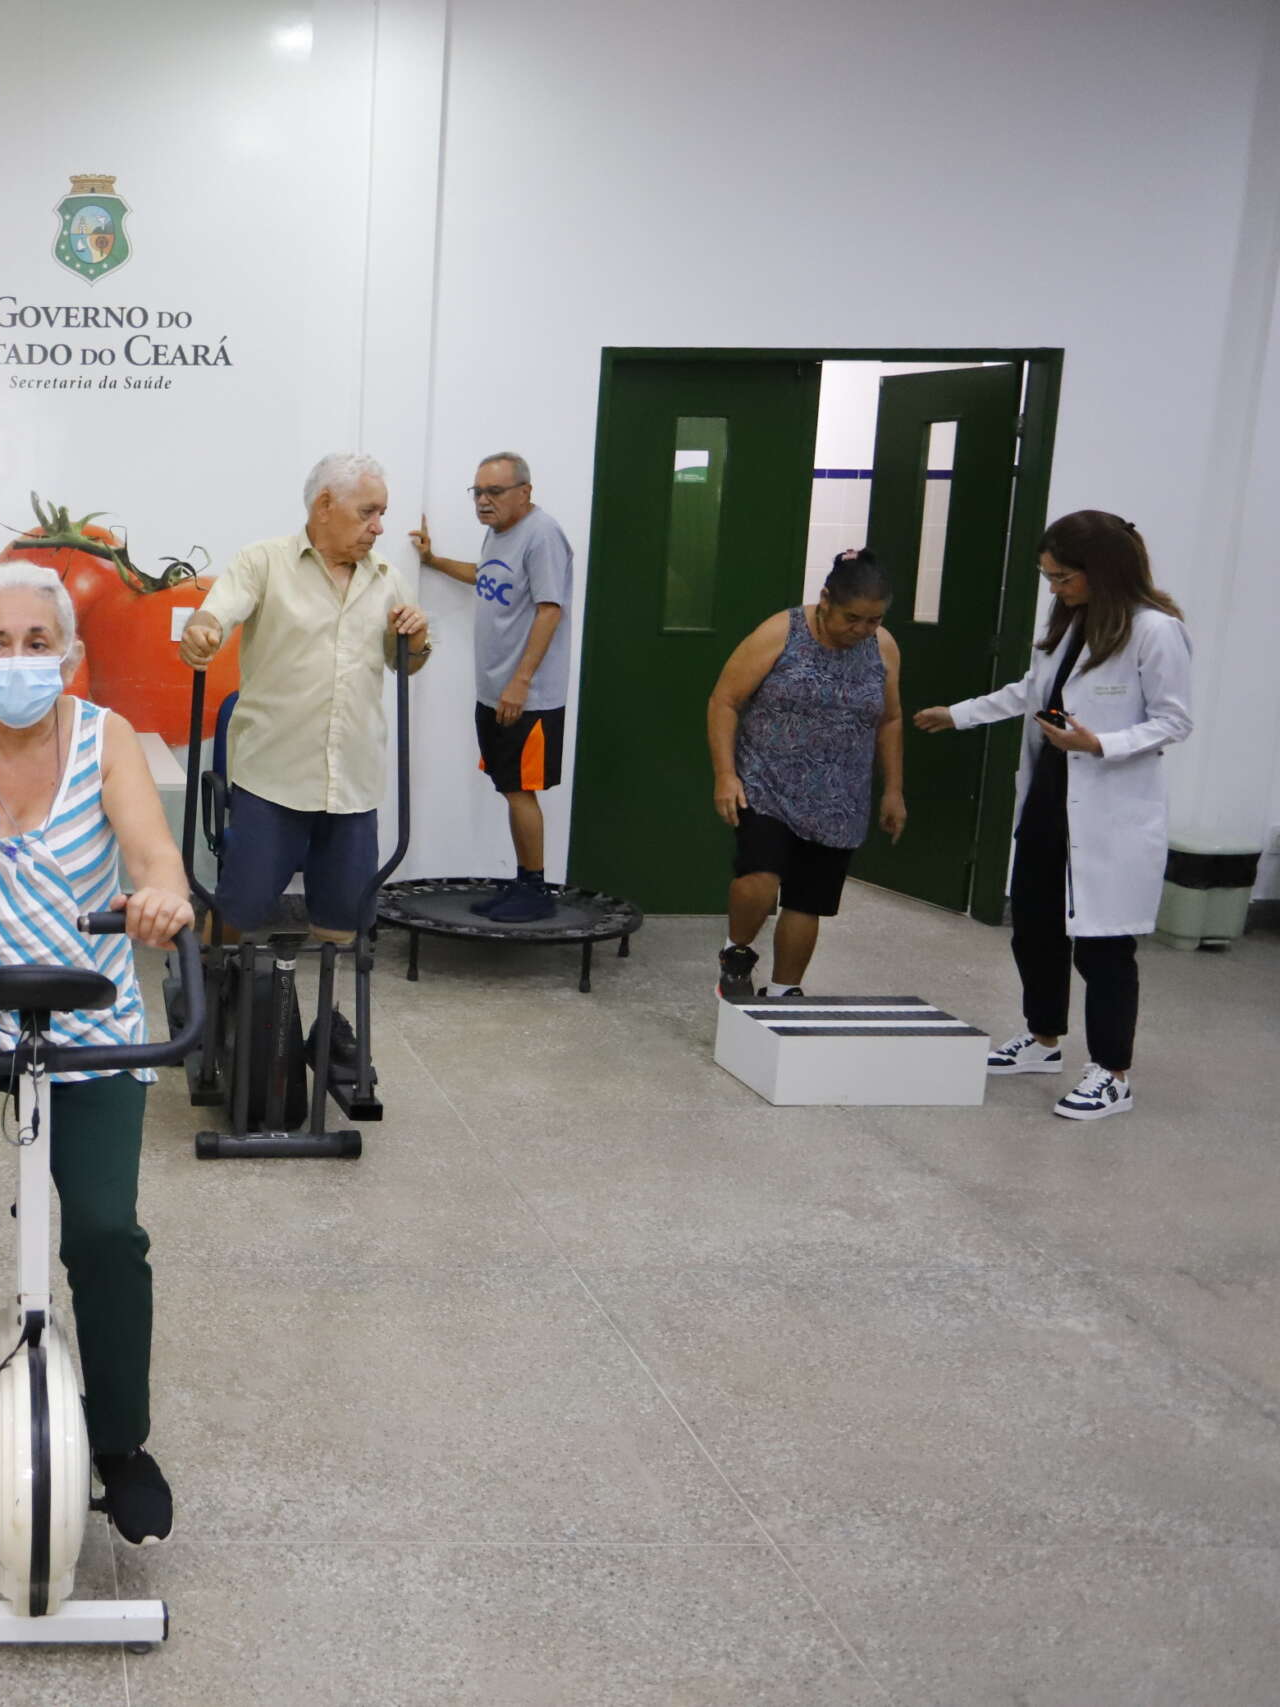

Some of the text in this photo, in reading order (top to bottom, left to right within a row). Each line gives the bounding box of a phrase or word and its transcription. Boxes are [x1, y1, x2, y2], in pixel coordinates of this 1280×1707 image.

[156, 311, 193, 329] DO
[80, 348, 116, 366] DO
[124, 335, 234, 366] CEARÁ
[8, 375, 173, 390] Secretaria da Saúde
